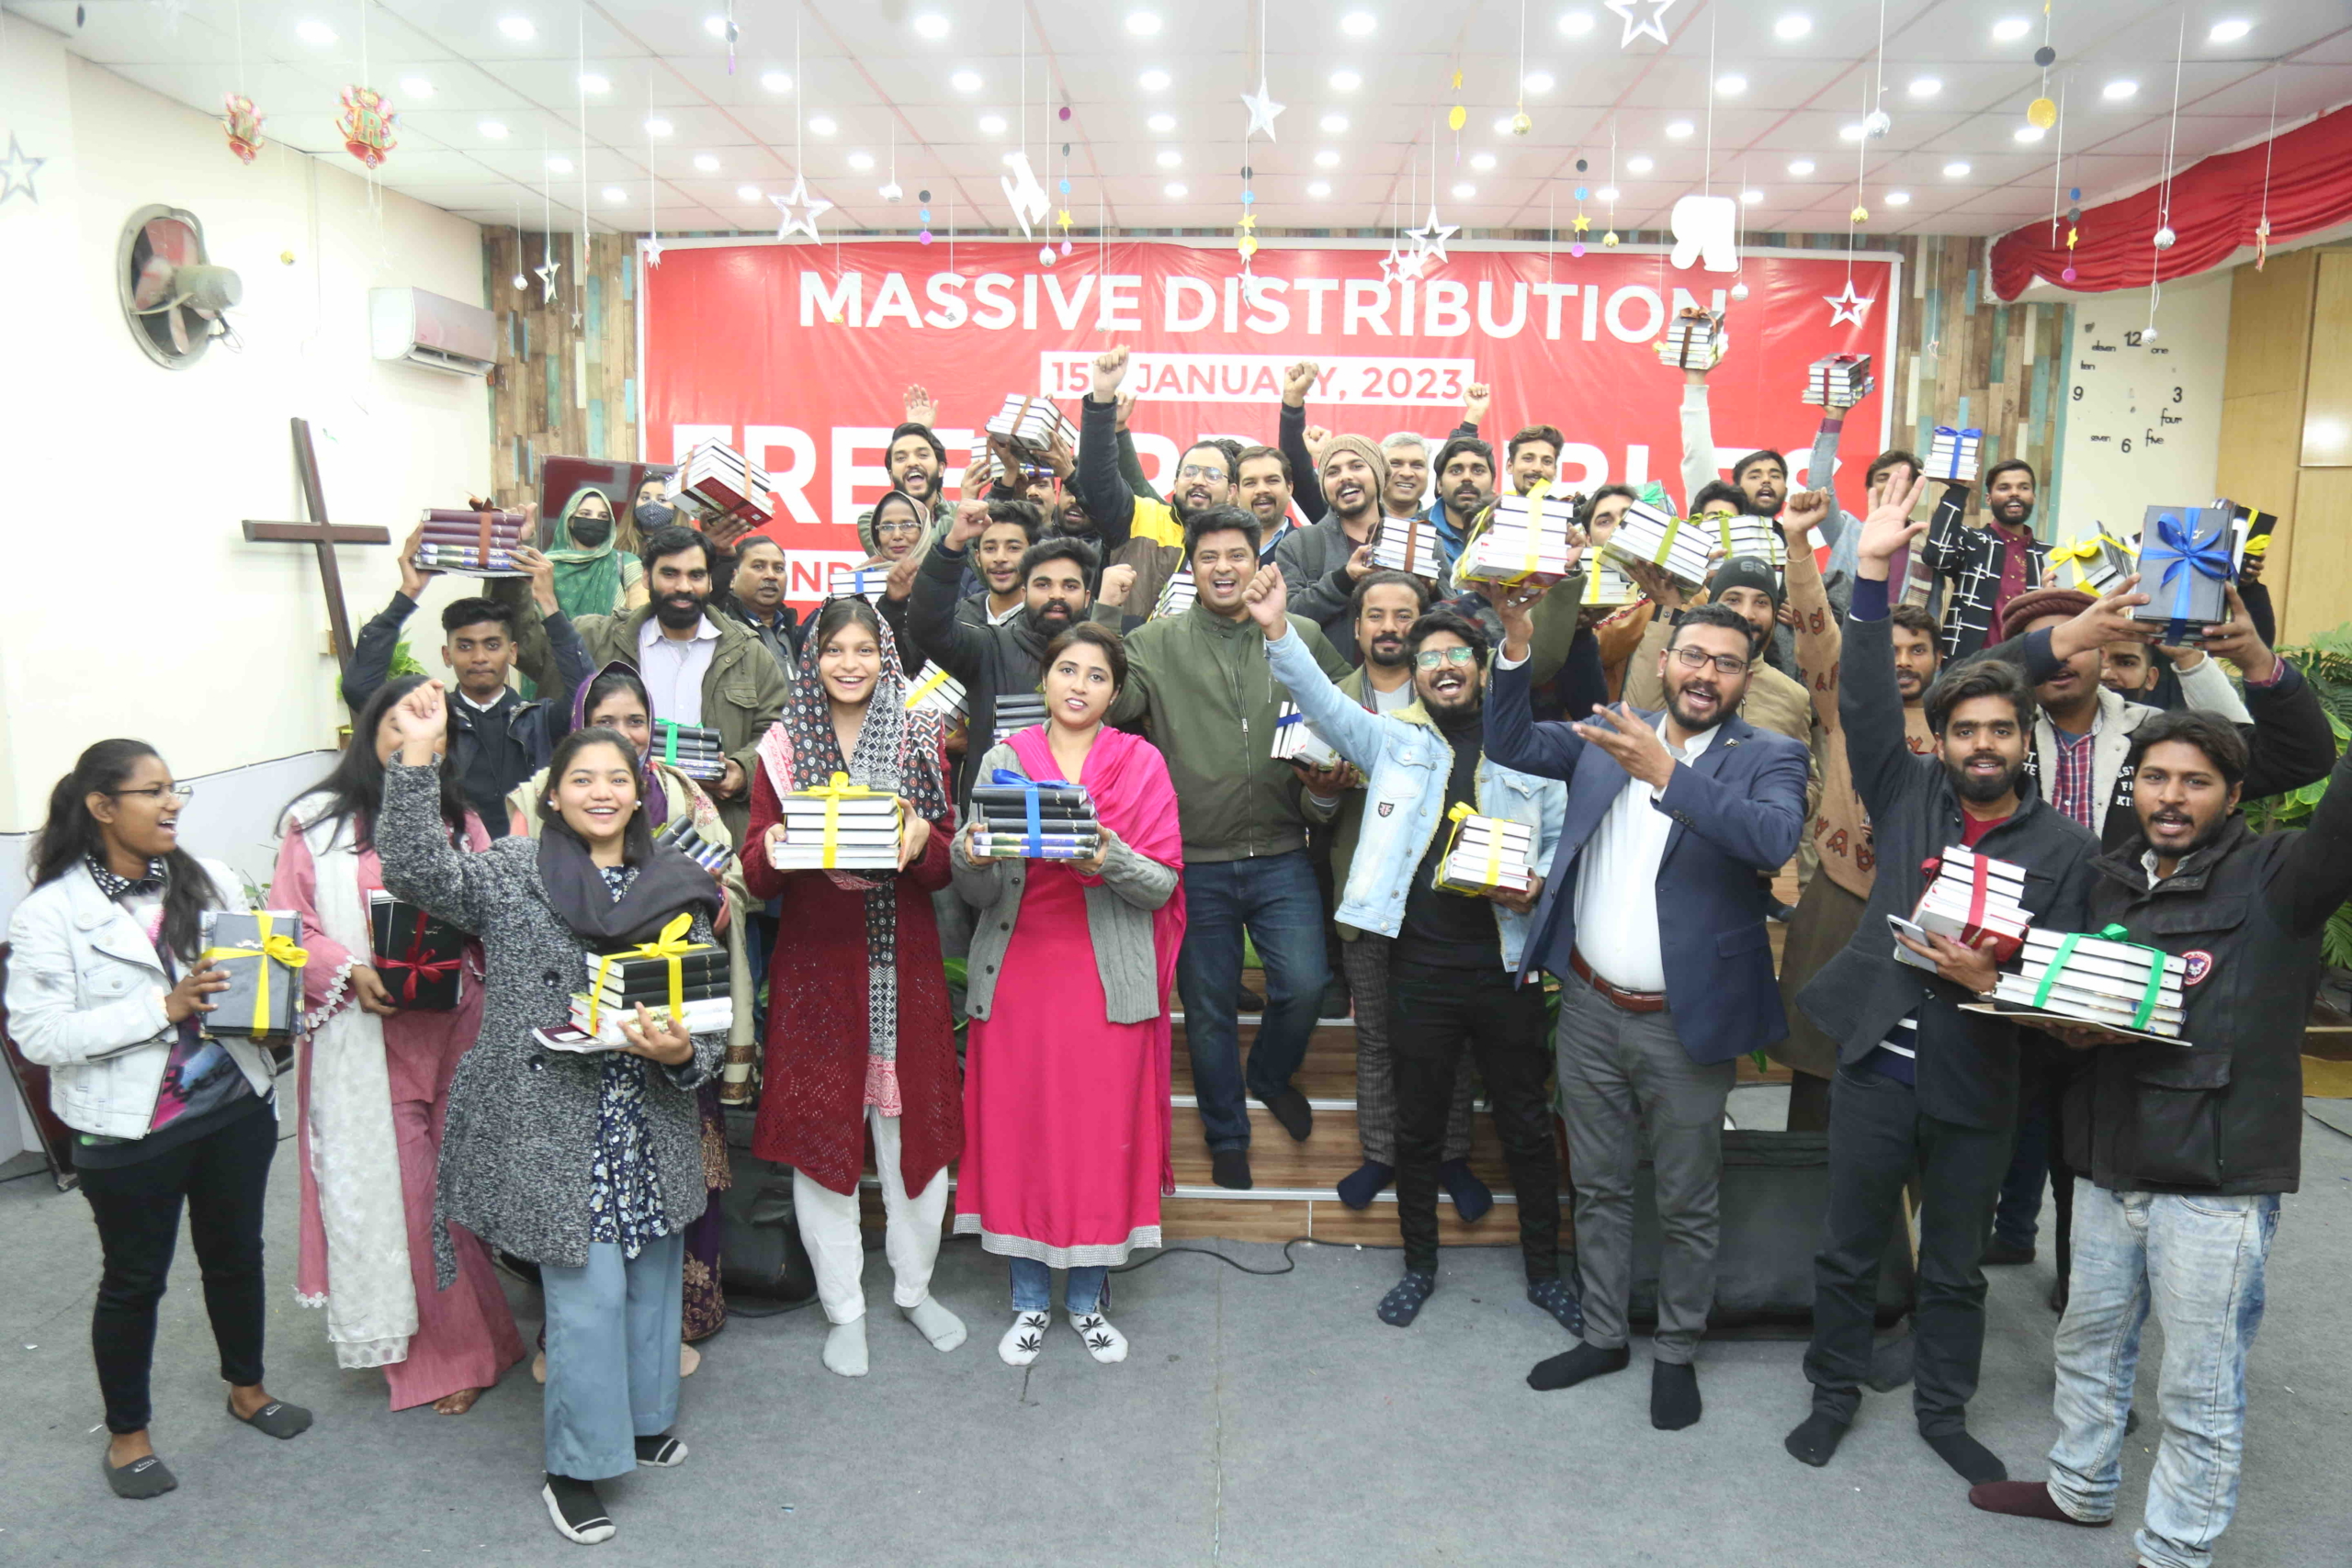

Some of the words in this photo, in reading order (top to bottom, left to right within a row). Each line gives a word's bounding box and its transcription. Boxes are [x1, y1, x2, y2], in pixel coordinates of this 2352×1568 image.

[800, 271, 1142, 332] MASSIVE
[2123, 331, 2142, 346] 12
[2091, 340, 2117, 353] eleven
[2151, 346, 2169, 355] one
[2080, 359, 2096, 370] ten
[1135, 363, 1348, 401] JANUAY,
[1361, 366, 1464, 400] 2023
[2072, 386, 2084, 400] 9
[2172, 387, 2183, 403] 3
[2160, 408, 2183, 426] four
[2090, 434, 2111, 443] seven
[2145, 428, 2165, 447] five
[2120, 438, 2132, 453] 6
